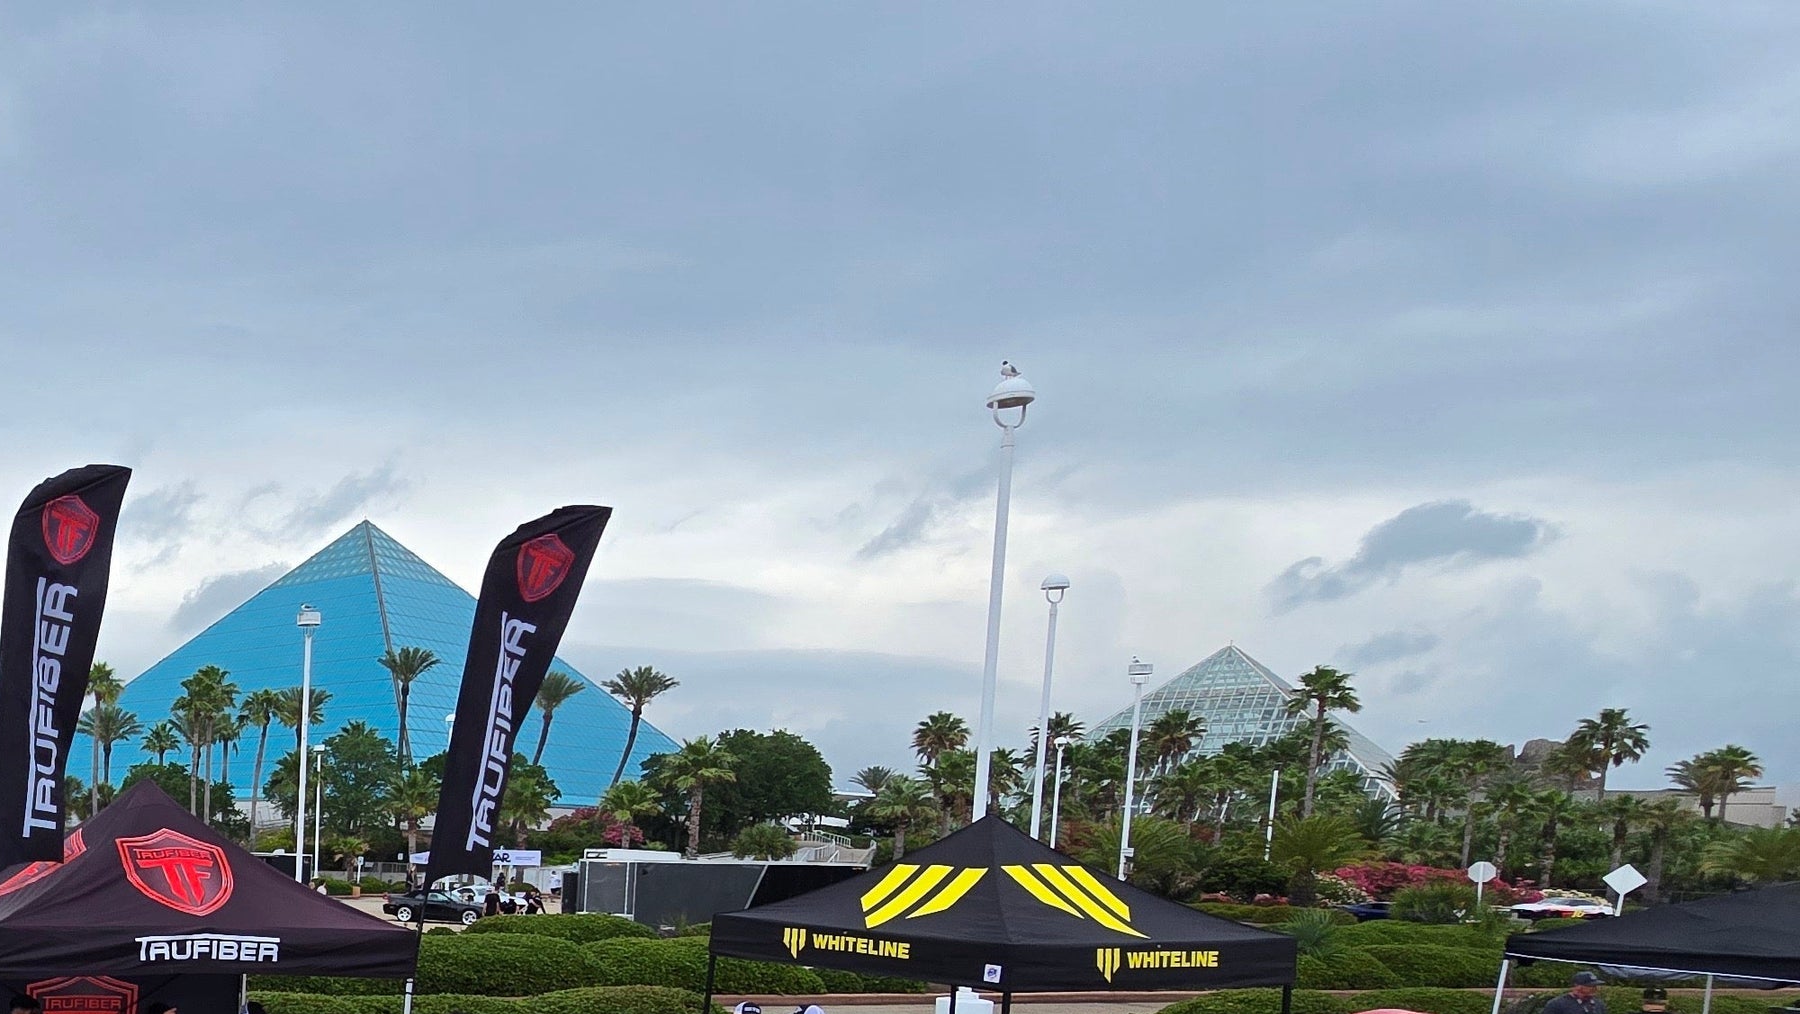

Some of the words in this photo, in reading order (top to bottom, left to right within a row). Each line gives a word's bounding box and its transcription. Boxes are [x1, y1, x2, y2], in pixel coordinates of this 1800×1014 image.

[22, 576, 78, 838] TRUFIBER
[466, 610, 537, 851] TRUFIBER
[133, 848, 212, 860] TRUFIBER
[135, 933, 281, 962] TRUFIBER
[812, 933, 911, 960] WHITELINE
[1126, 950, 1219, 969] WHITELINE
[43, 995, 123, 1010] TRUFIBER
